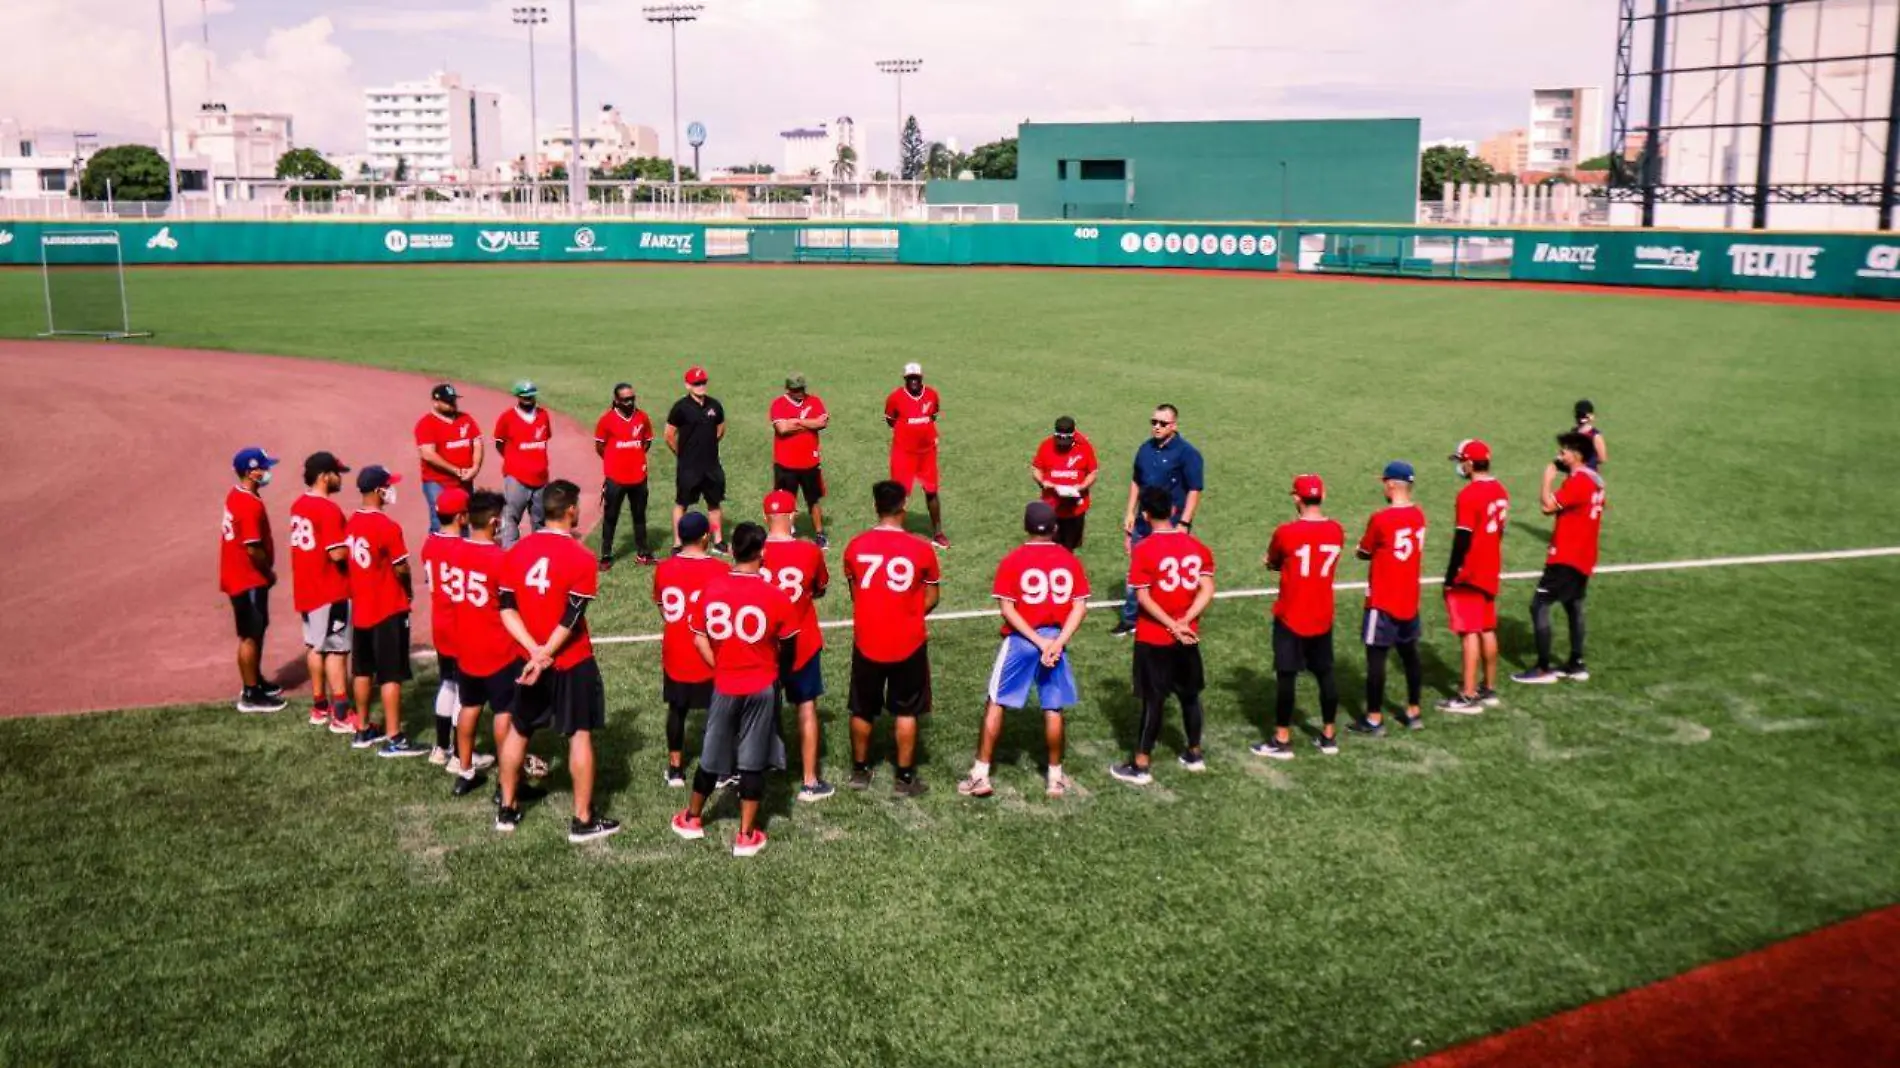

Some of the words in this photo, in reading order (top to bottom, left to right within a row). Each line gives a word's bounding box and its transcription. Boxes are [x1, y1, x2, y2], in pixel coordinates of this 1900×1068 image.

[1074, 228, 1099, 239] 400
[1727, 244, 1825, 279] TECATE
[1295, 544, 1341, 578] 17
[1394, 527, 1426, 562] 51
[441, 566, 489, 608] 35
[524, 556, 550, 595] 4
[758, 566, 804, 603] 8
[856, 554, 915, 592] 79
[1020, 568, 1074, 605] 99
[1158, 555, 1203, 593] 33
[661, 586, 701, 623] 9
[705, 601, 767, 644] 80
